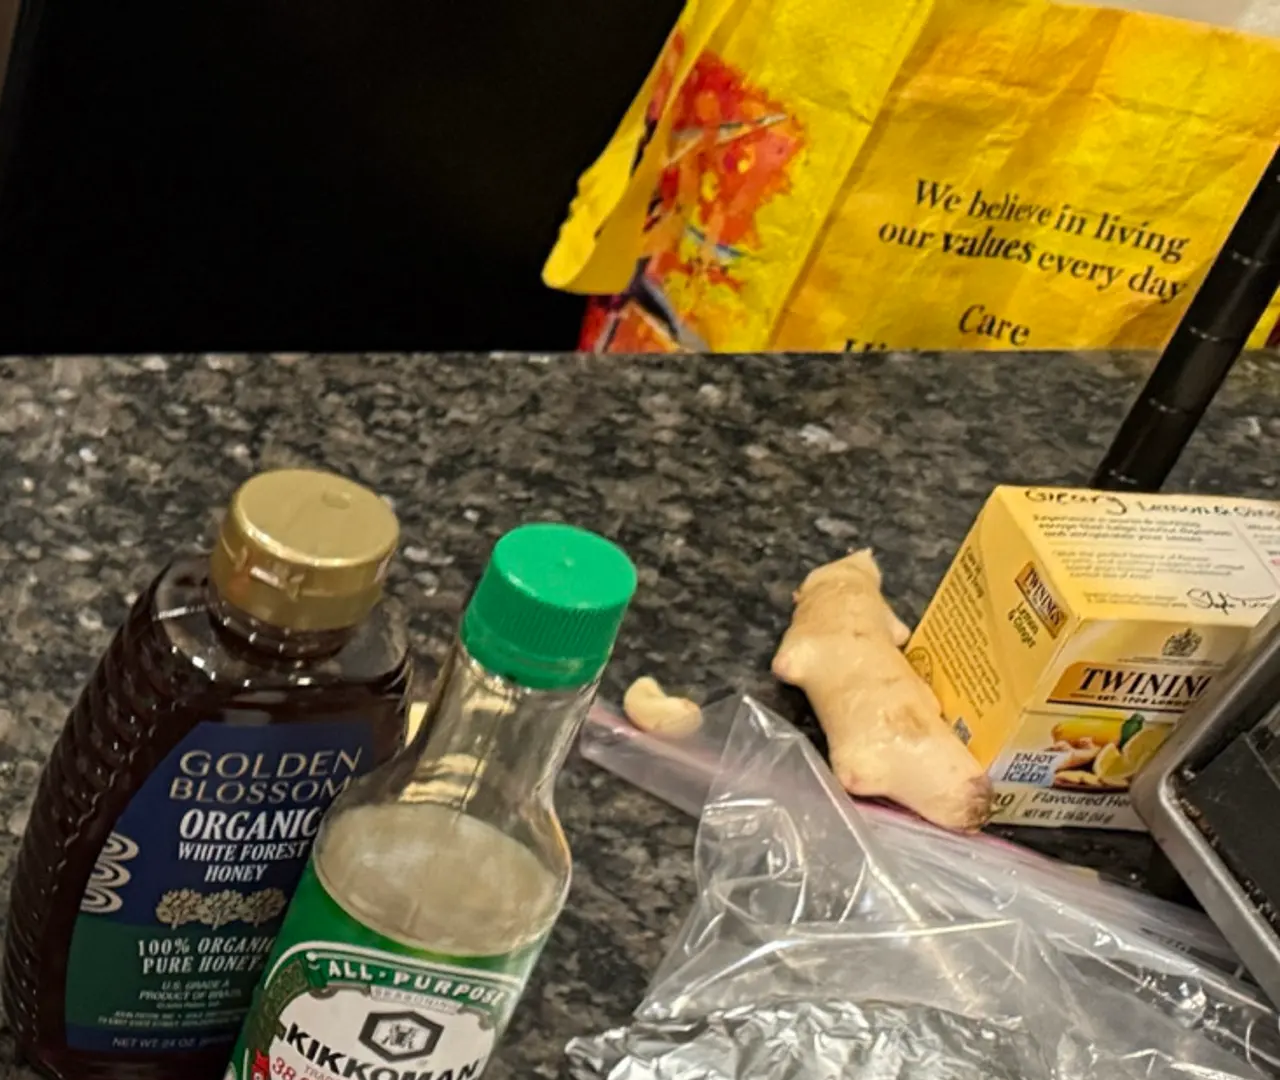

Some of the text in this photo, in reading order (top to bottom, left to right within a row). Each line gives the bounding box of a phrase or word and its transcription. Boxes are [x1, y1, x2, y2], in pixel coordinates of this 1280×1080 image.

[916, 179, 1190, 264] We believe in living
[879, 222, 1188, 304] our values every day
[959, 304, 1029, 345] Care
[179, 747, 363, 779] GOLDEN
[1010, 763, 1037, 773] HOT
[1015, 753, 1057, 763] ENJOY
[169, 775, 351, 805] BLOSSOM
[1032, 792, 1105, 806] Flavoured
[179, 807, 320, 841] ORGANIC
[178, 840, 310, 861] WHITE FOREST
[204, 864, 267, 882] HONEY
[138, 938, 190, 956] 100%
[143, 956, 192, 975] PURE
[139, 989, 189, 1001] PRODUCT
